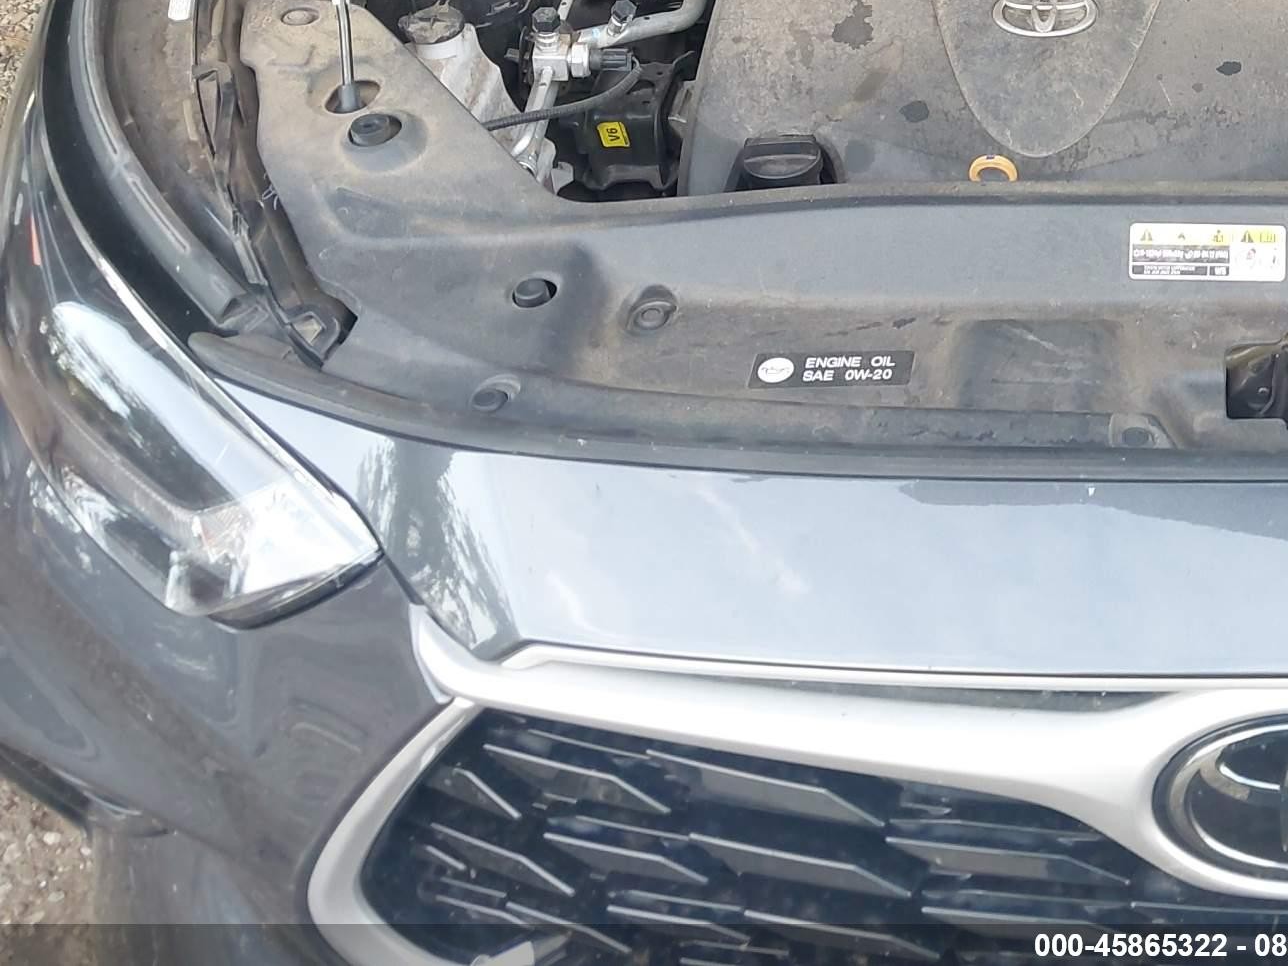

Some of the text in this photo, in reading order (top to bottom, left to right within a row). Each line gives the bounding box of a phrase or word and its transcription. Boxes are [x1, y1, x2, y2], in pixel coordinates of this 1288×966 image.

[606, 127, 621, 141] V6
[805, 355, 896, 369] ENGINE OIL
[802, 368, 893, 382] SAE 0W-20
